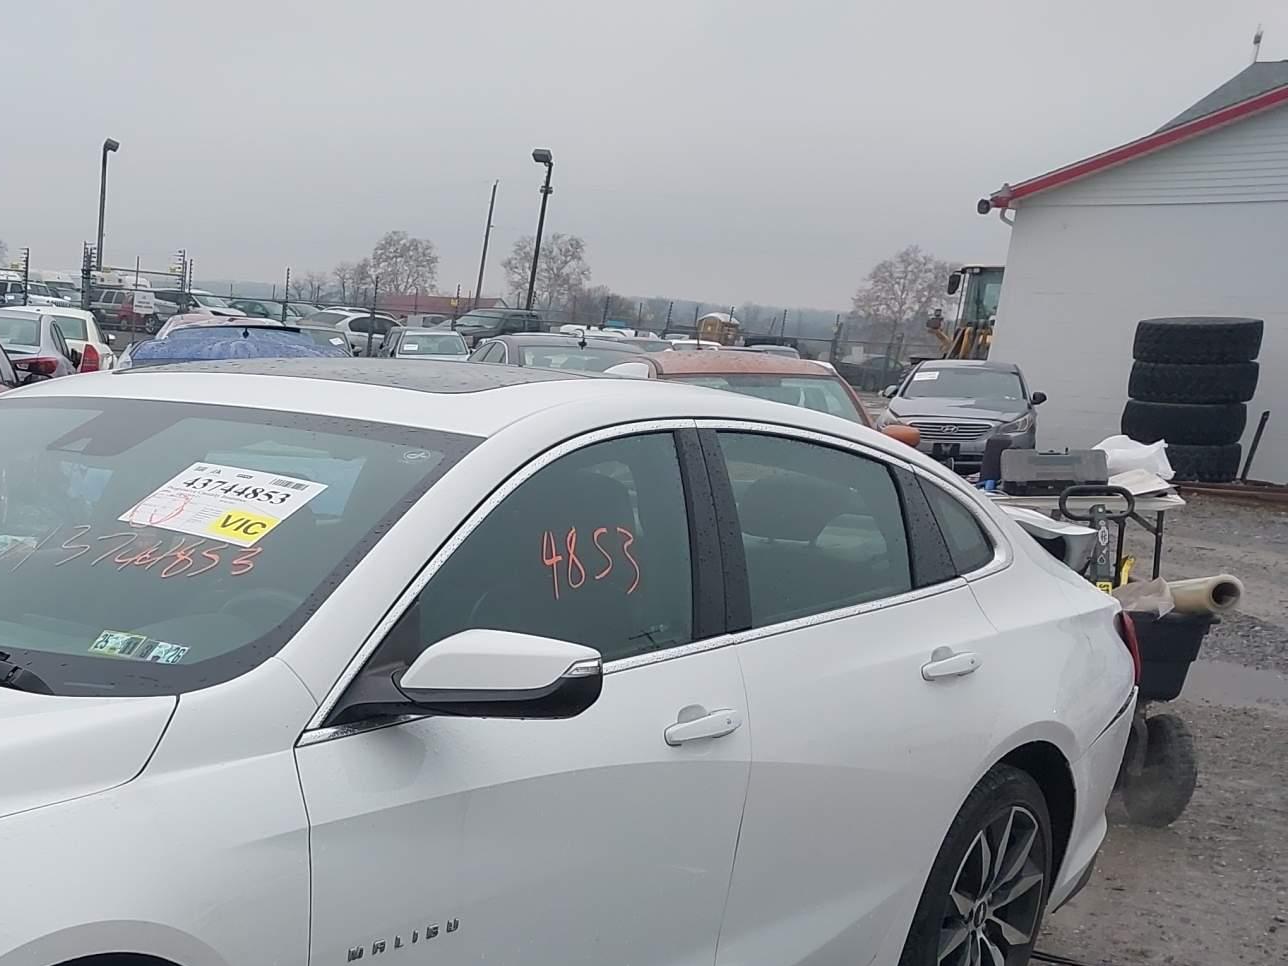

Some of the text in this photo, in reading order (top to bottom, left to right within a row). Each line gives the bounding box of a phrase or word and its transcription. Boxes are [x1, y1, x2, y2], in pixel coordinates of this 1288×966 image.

[183, 477, 291, 505] 43744853
[221, 514, 266, 536] VIC
[543, 526, 640, 600] 4853
[347, 918, 460, 962] MALIBU
